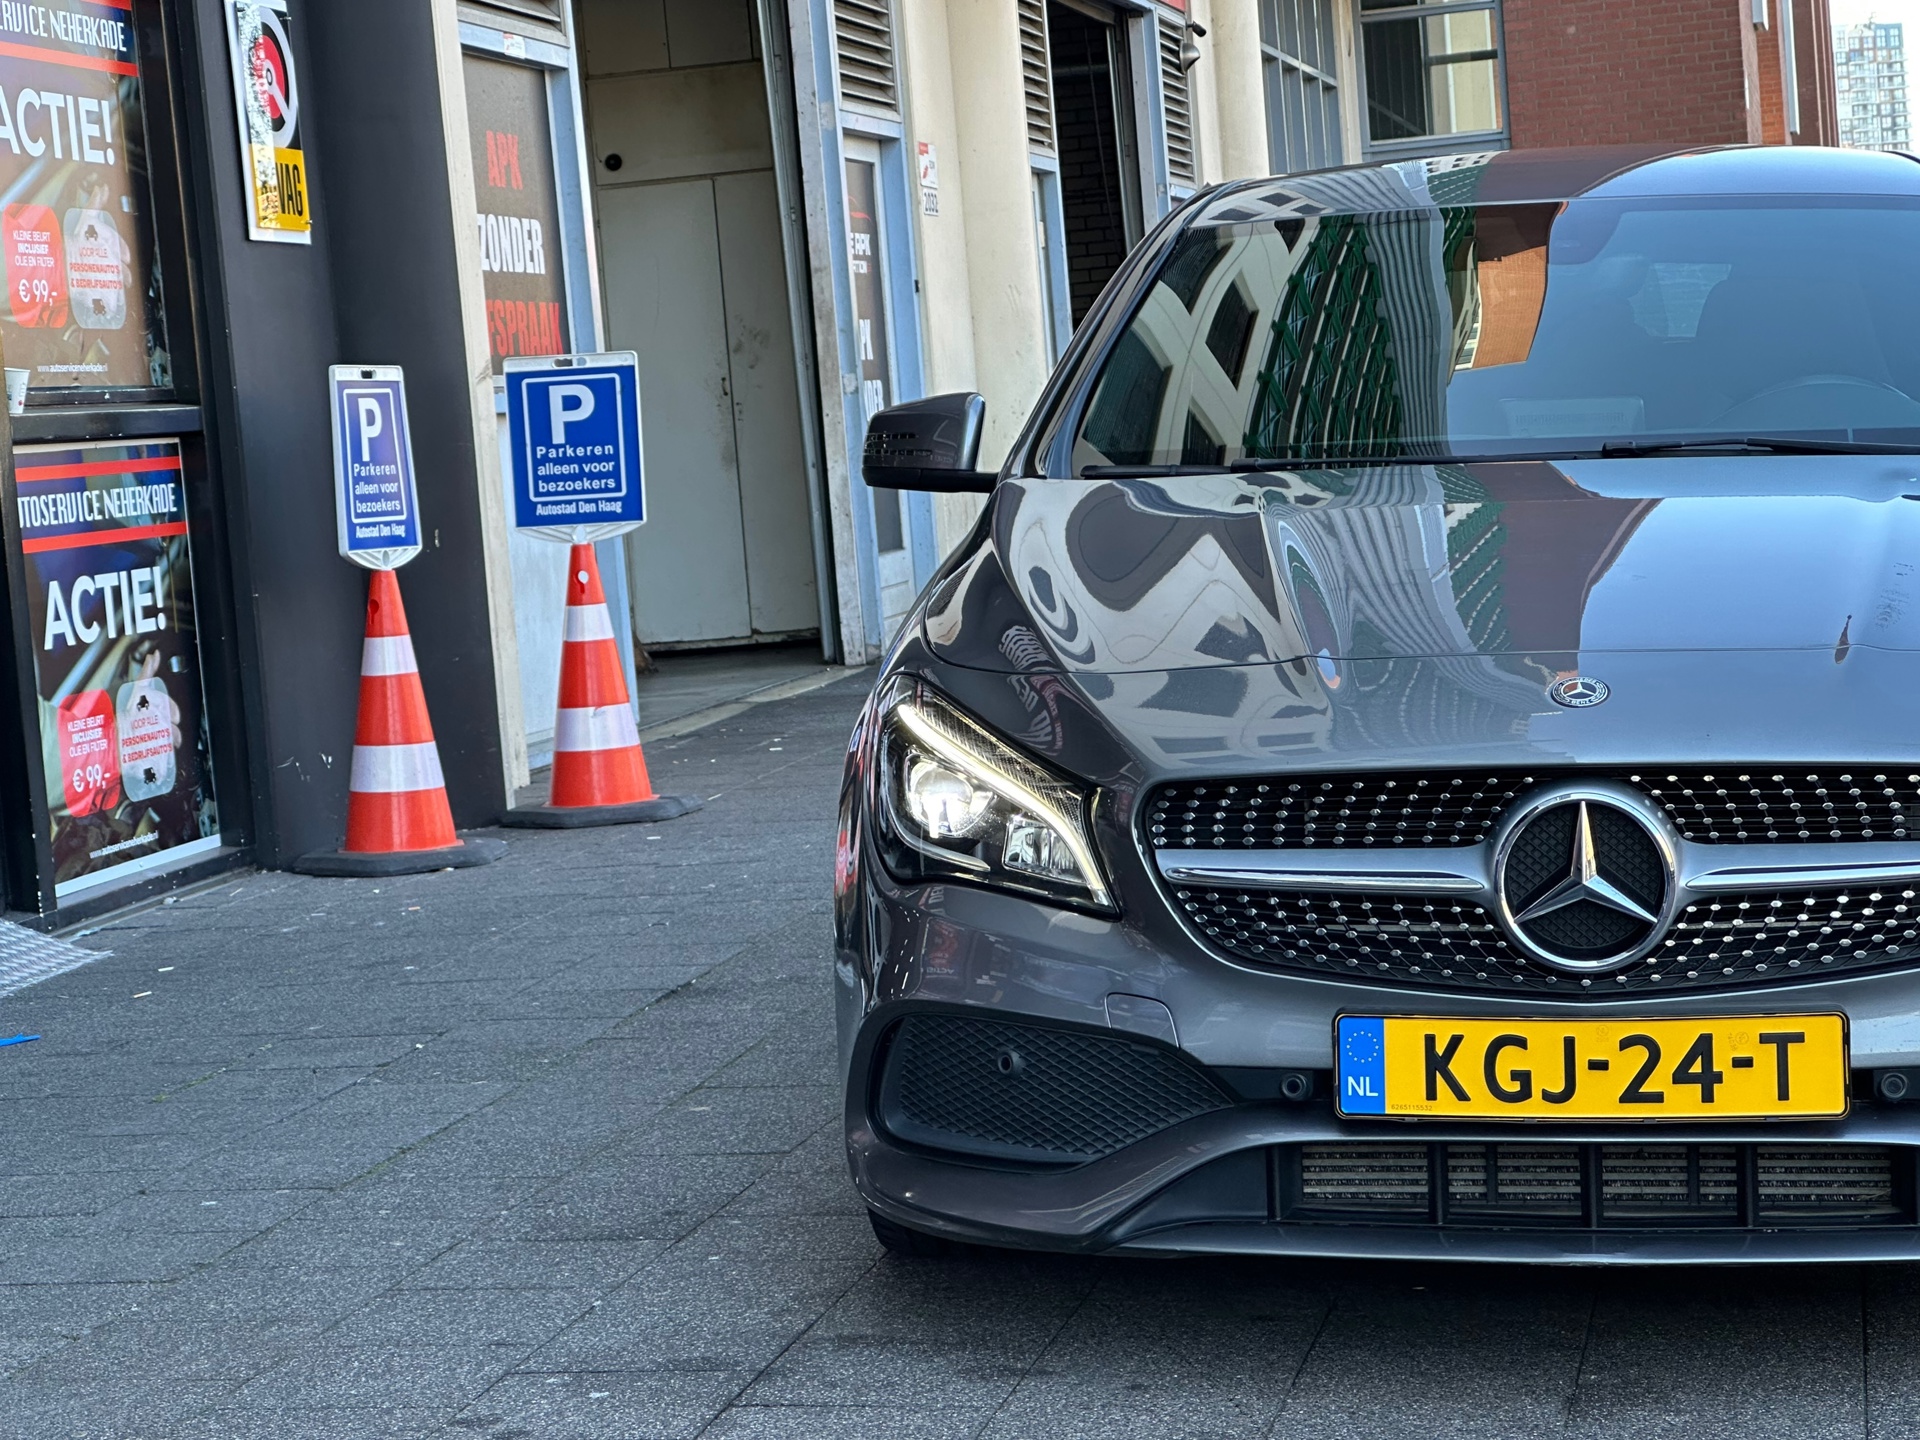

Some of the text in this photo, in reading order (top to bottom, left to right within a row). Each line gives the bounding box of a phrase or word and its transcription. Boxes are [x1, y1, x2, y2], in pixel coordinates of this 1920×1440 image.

[0, 0, 127, 51] RVICE NEHERKADE
[486, 130, 523, 190] APK
[266, 161, 303, 217] VAG
[477, 213, 545, 275] ZONDER
[549, 383, 596, 444] P
[357, 397, 382, 462] P
[536, 444, 614, 459] Parkeren
[353, 463, 397, 476] Parkeren
[537, 461, 615, 476] alleen voor
[354, 481, 398, 495] alleen voor
[538, 477, 616, 492] bezoekers
[102, 483, 177, 519] NEHERKADE
[355, 498, 401, 513] bezoekers
[536, 500, 622, 516] Autostad Den Haag
[44, 566, 166, 651] ACTIE!
[73, 769, 84, 793] €
[1424, 1032, 1806, 1104] KGJ-24-T
[1347, 1075, 1379, 1097] NL
